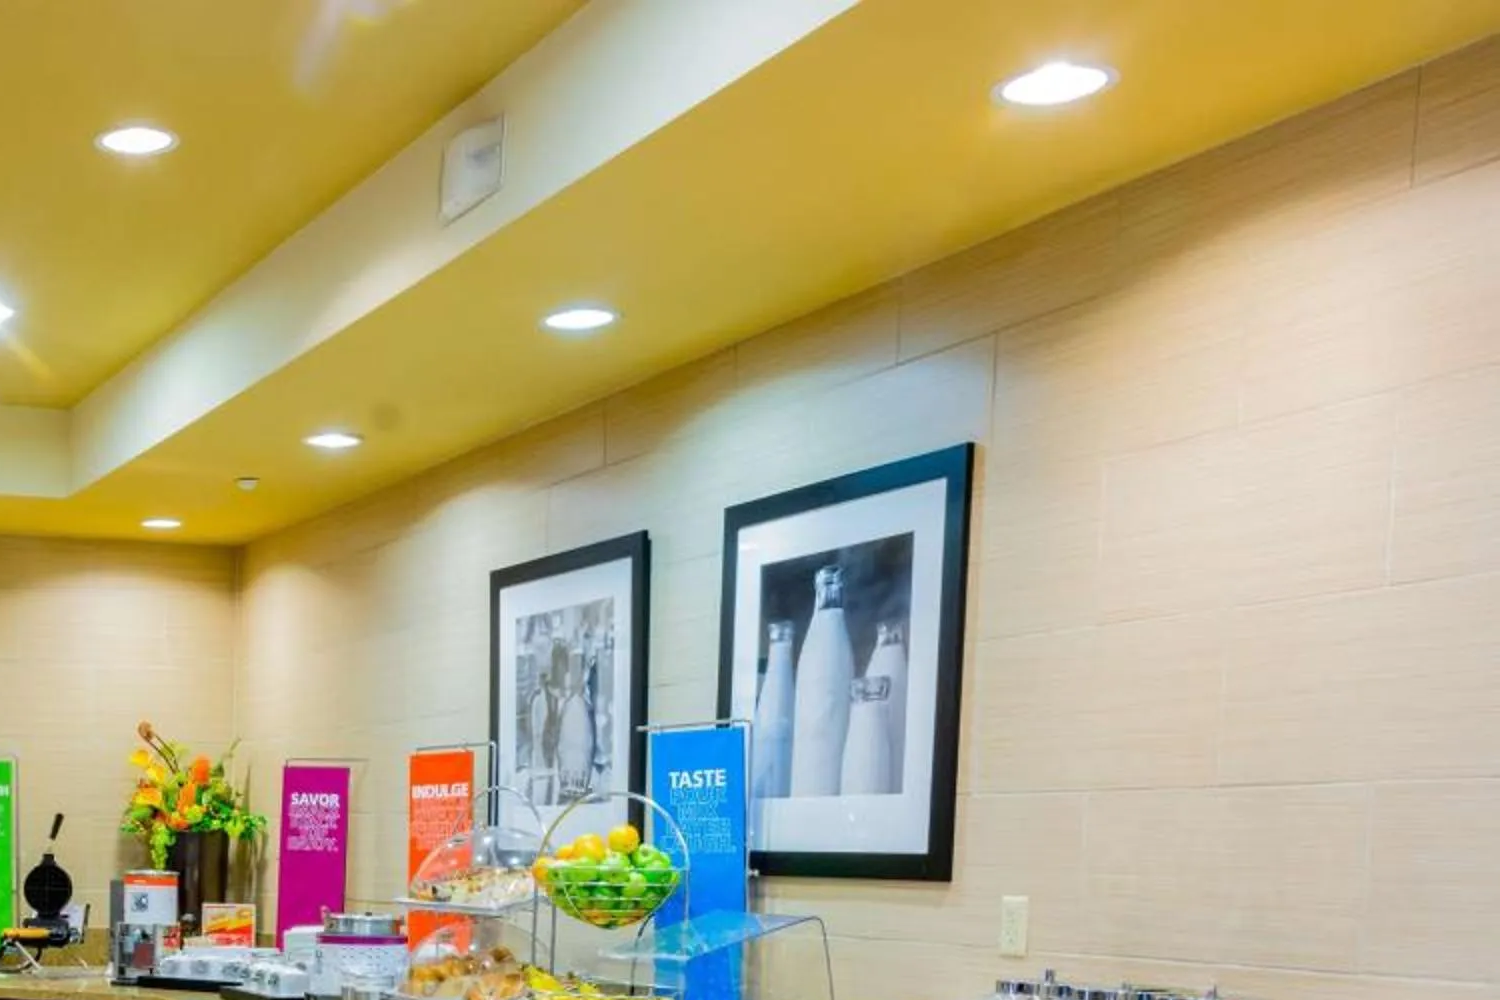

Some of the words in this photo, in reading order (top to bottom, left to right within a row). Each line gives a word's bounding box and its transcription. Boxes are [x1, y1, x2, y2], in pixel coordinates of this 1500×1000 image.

[668, 768, 727, 789] TASTE
[411, 782, 469, 799] INDULGE
[291, 792, 340, 808] SAVOR
